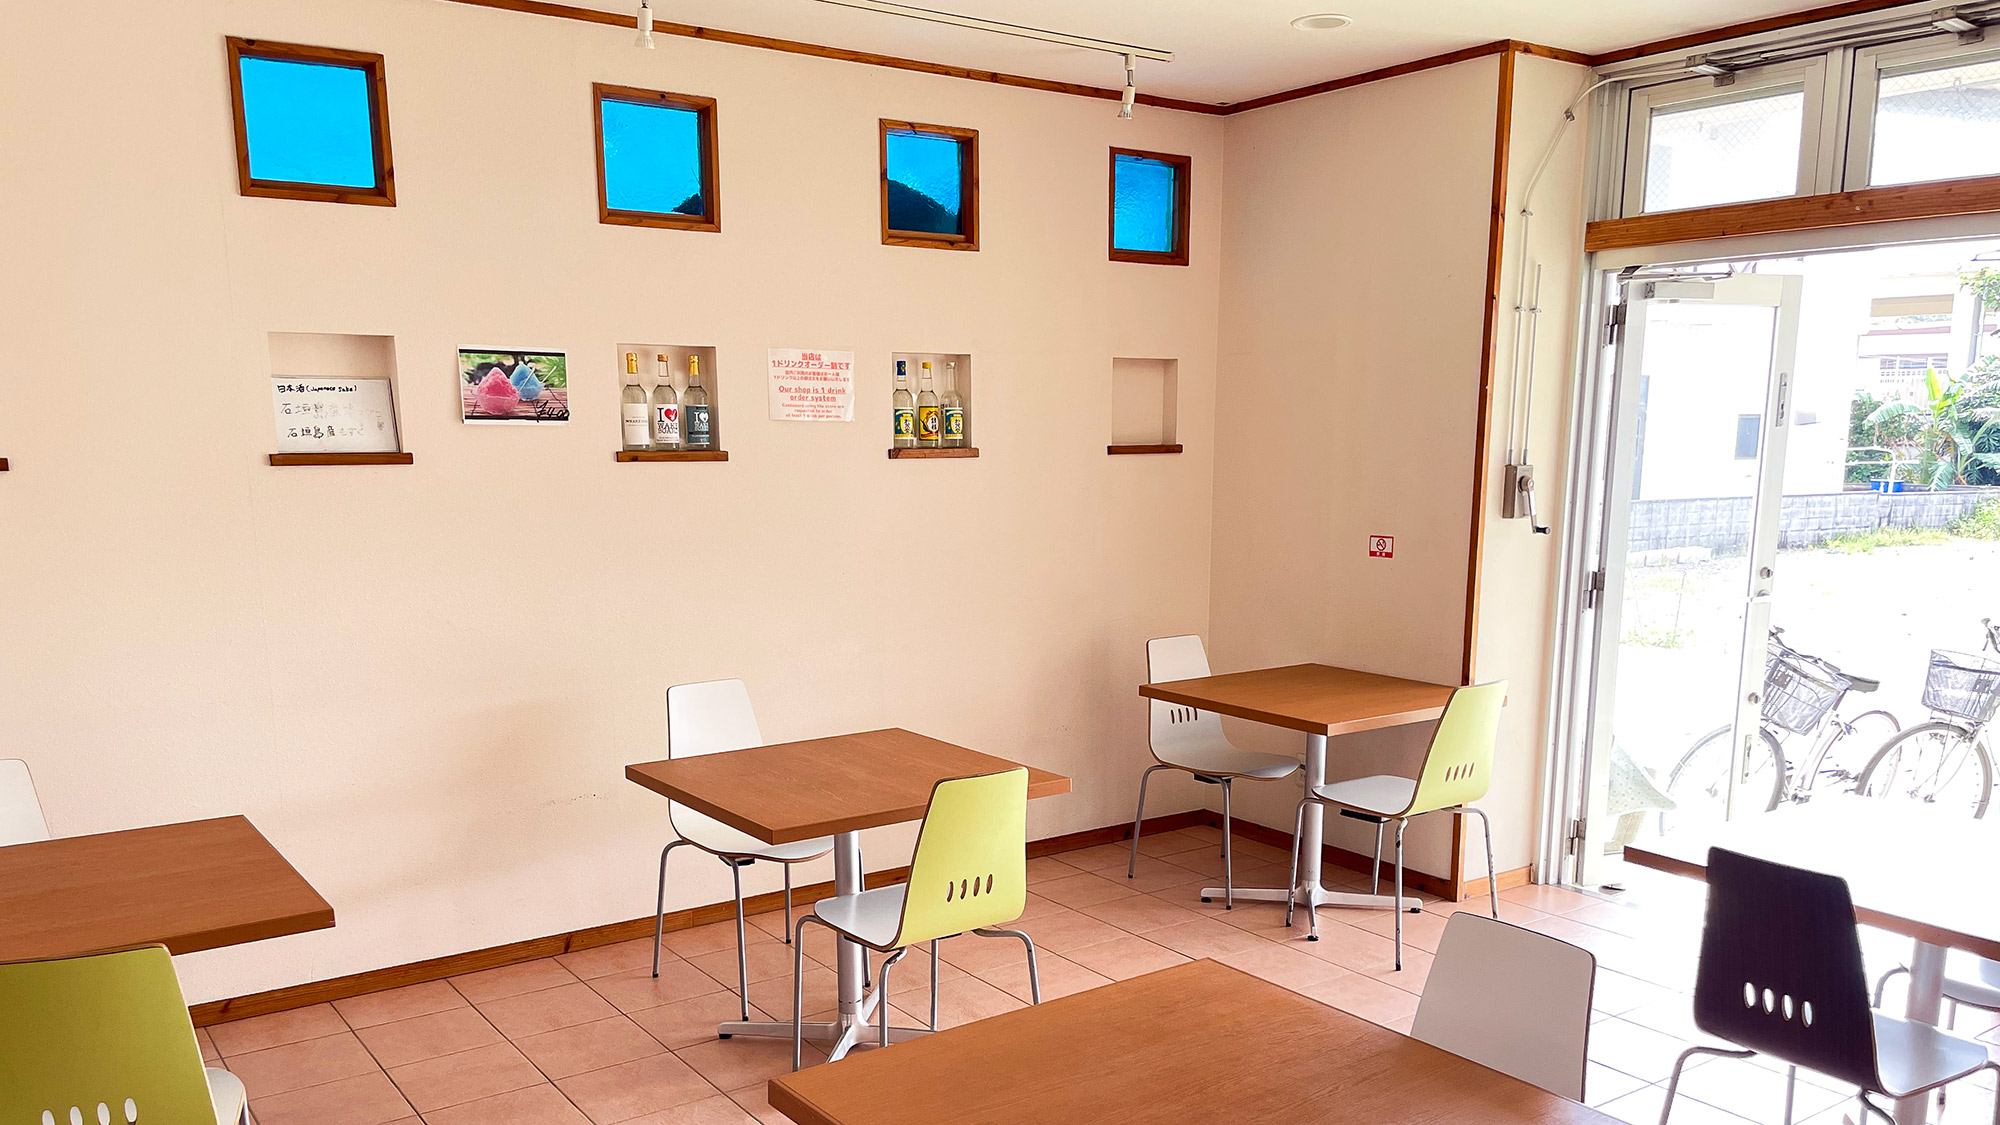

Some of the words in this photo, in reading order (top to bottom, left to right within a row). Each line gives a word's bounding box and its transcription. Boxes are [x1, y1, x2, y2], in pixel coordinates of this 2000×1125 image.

[772, 360, 850, 370] 1ドリンクオーダー制です
[795, 386, 811, 394] shop
[657, 408, 665, 423] I
